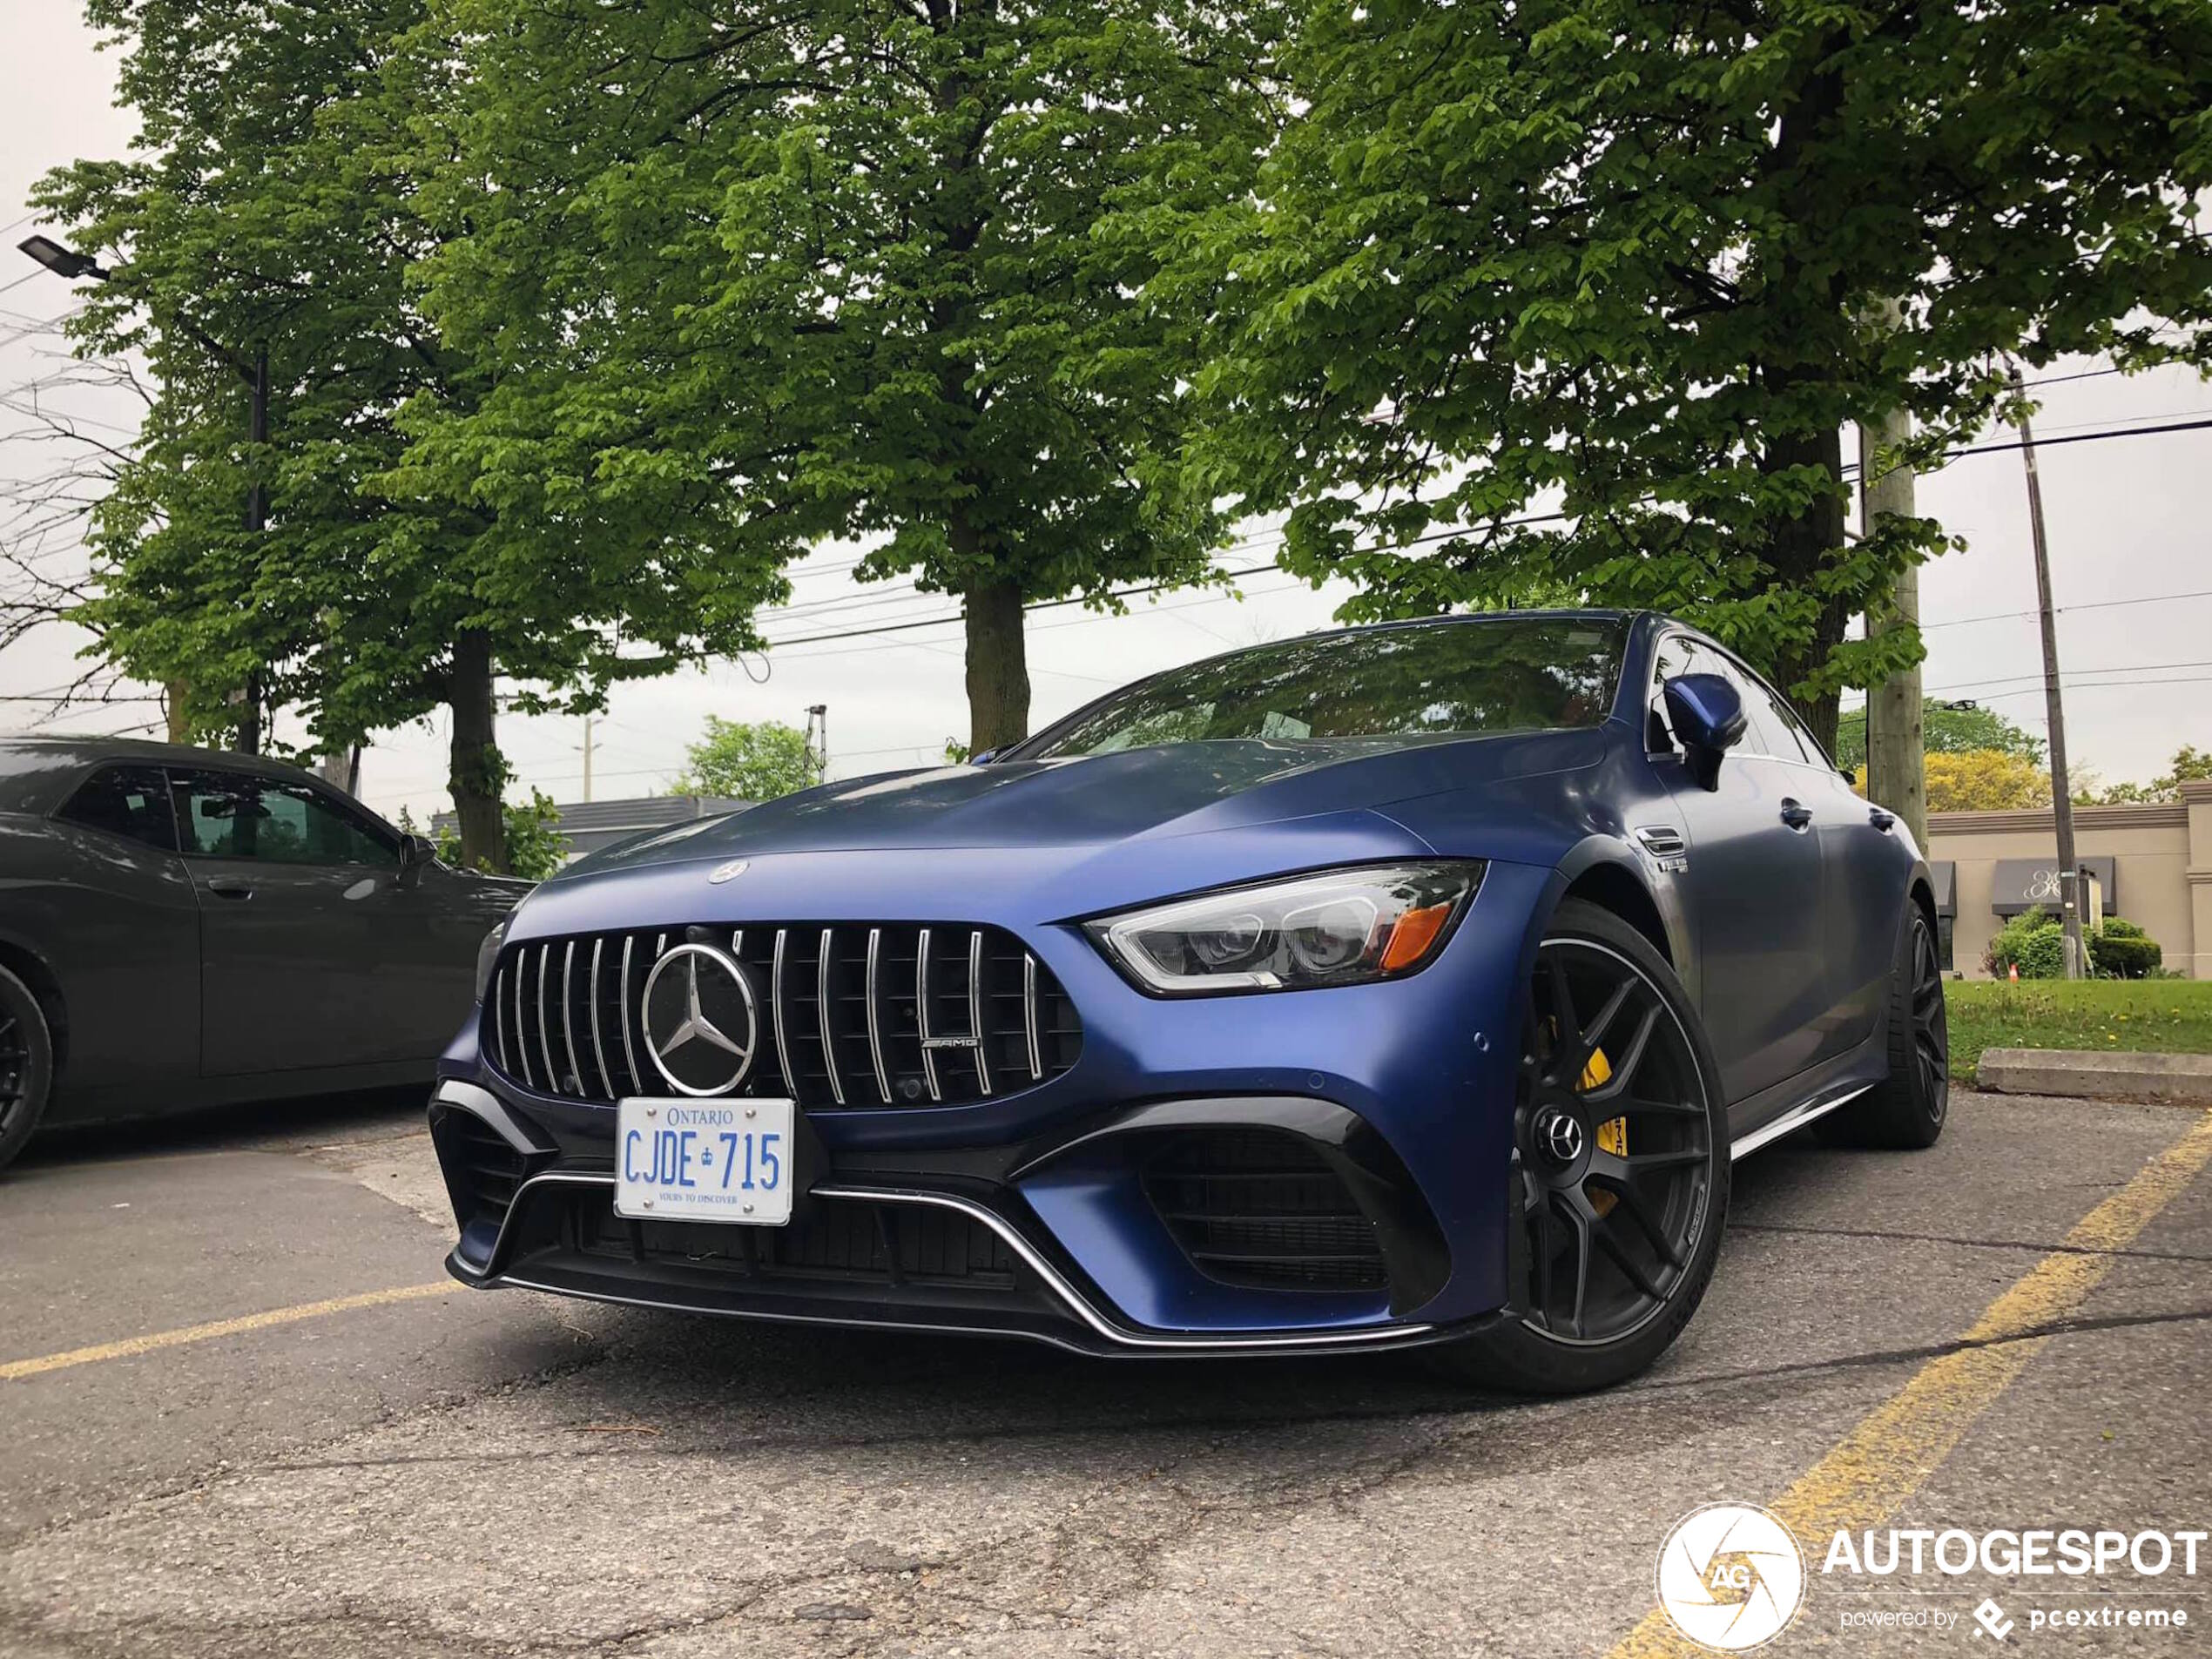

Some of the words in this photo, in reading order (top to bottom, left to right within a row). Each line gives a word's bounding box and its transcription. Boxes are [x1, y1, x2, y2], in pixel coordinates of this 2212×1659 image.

[938, 1038, 978, 1047] AMG
[667, 1107, 733, 1127] ONTARIO
[624, 1129, 697, 1187] CJDE
[719, 1132, 780, 1190] 715
[659, 1191, 683, 1202] YOURS
[685, 1192, 696, 1203] TO
[698, 1193, 738, 1204] DISCOVER
